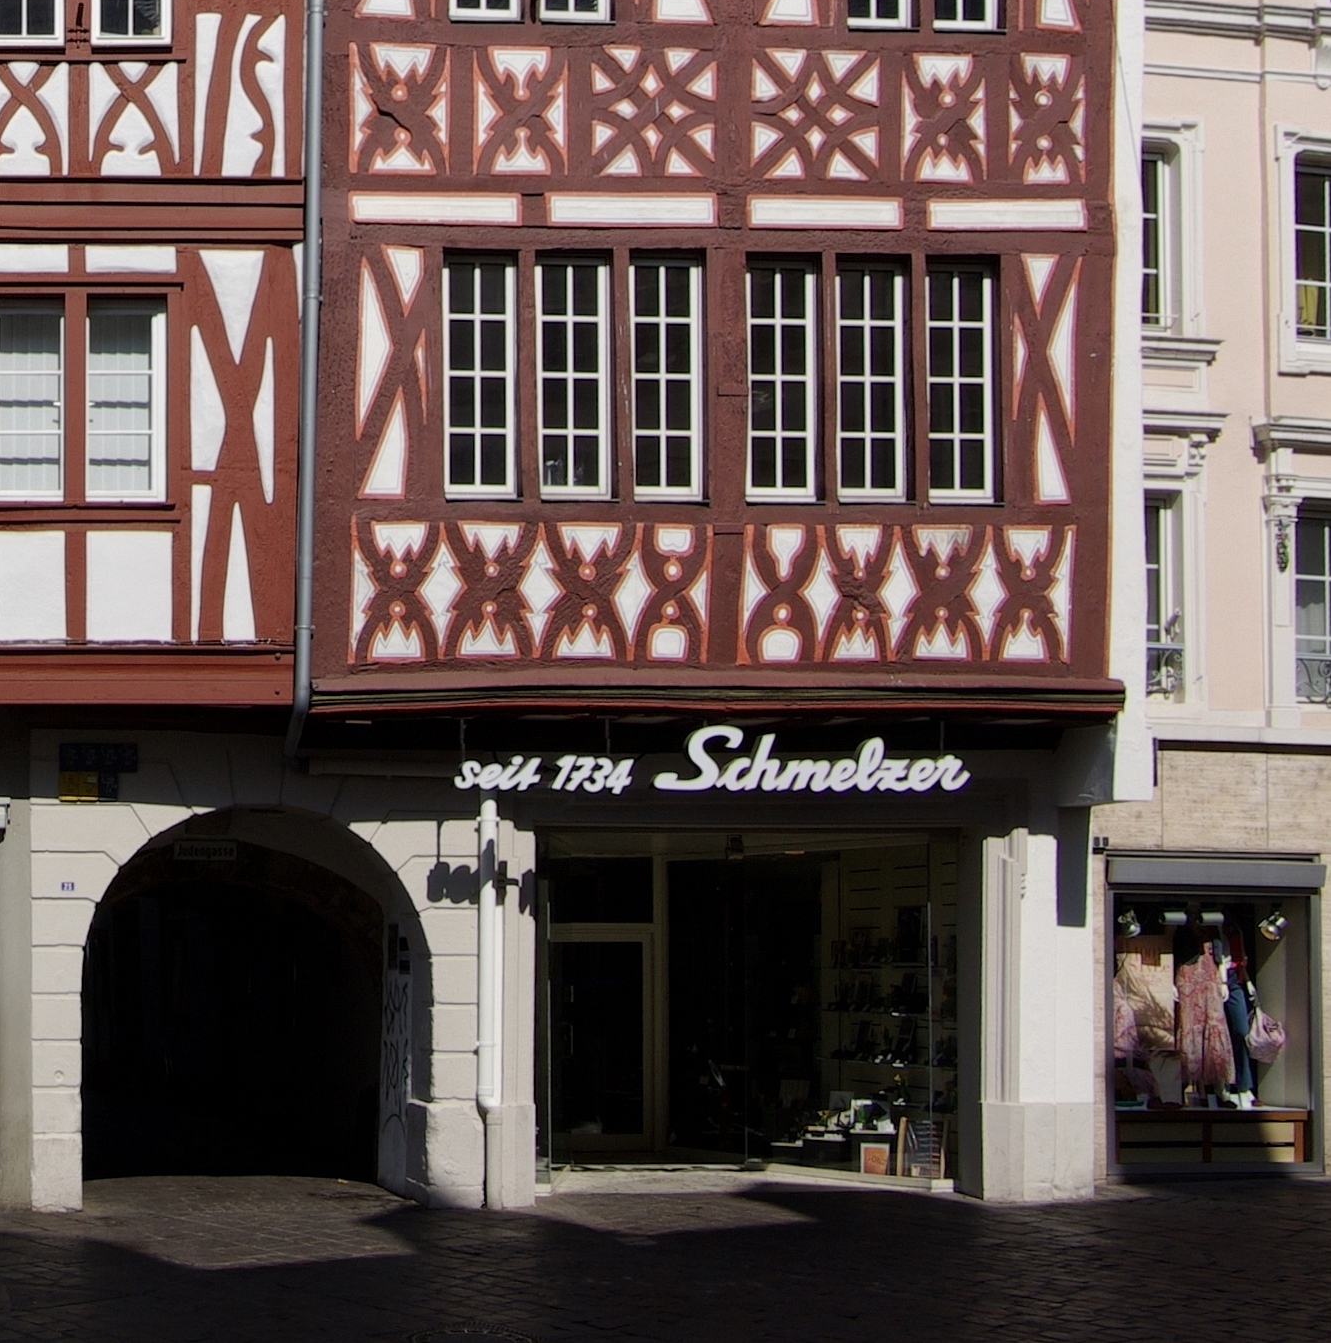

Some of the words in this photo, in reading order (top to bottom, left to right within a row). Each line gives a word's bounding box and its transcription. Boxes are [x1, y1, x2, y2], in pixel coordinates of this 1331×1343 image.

[454, 754, 542, 791] seit
[550, 754, 634, 795] 1734
[653, 725, 972, 794] Schmelzer
[177, 844, 235, 859] Judengasse
